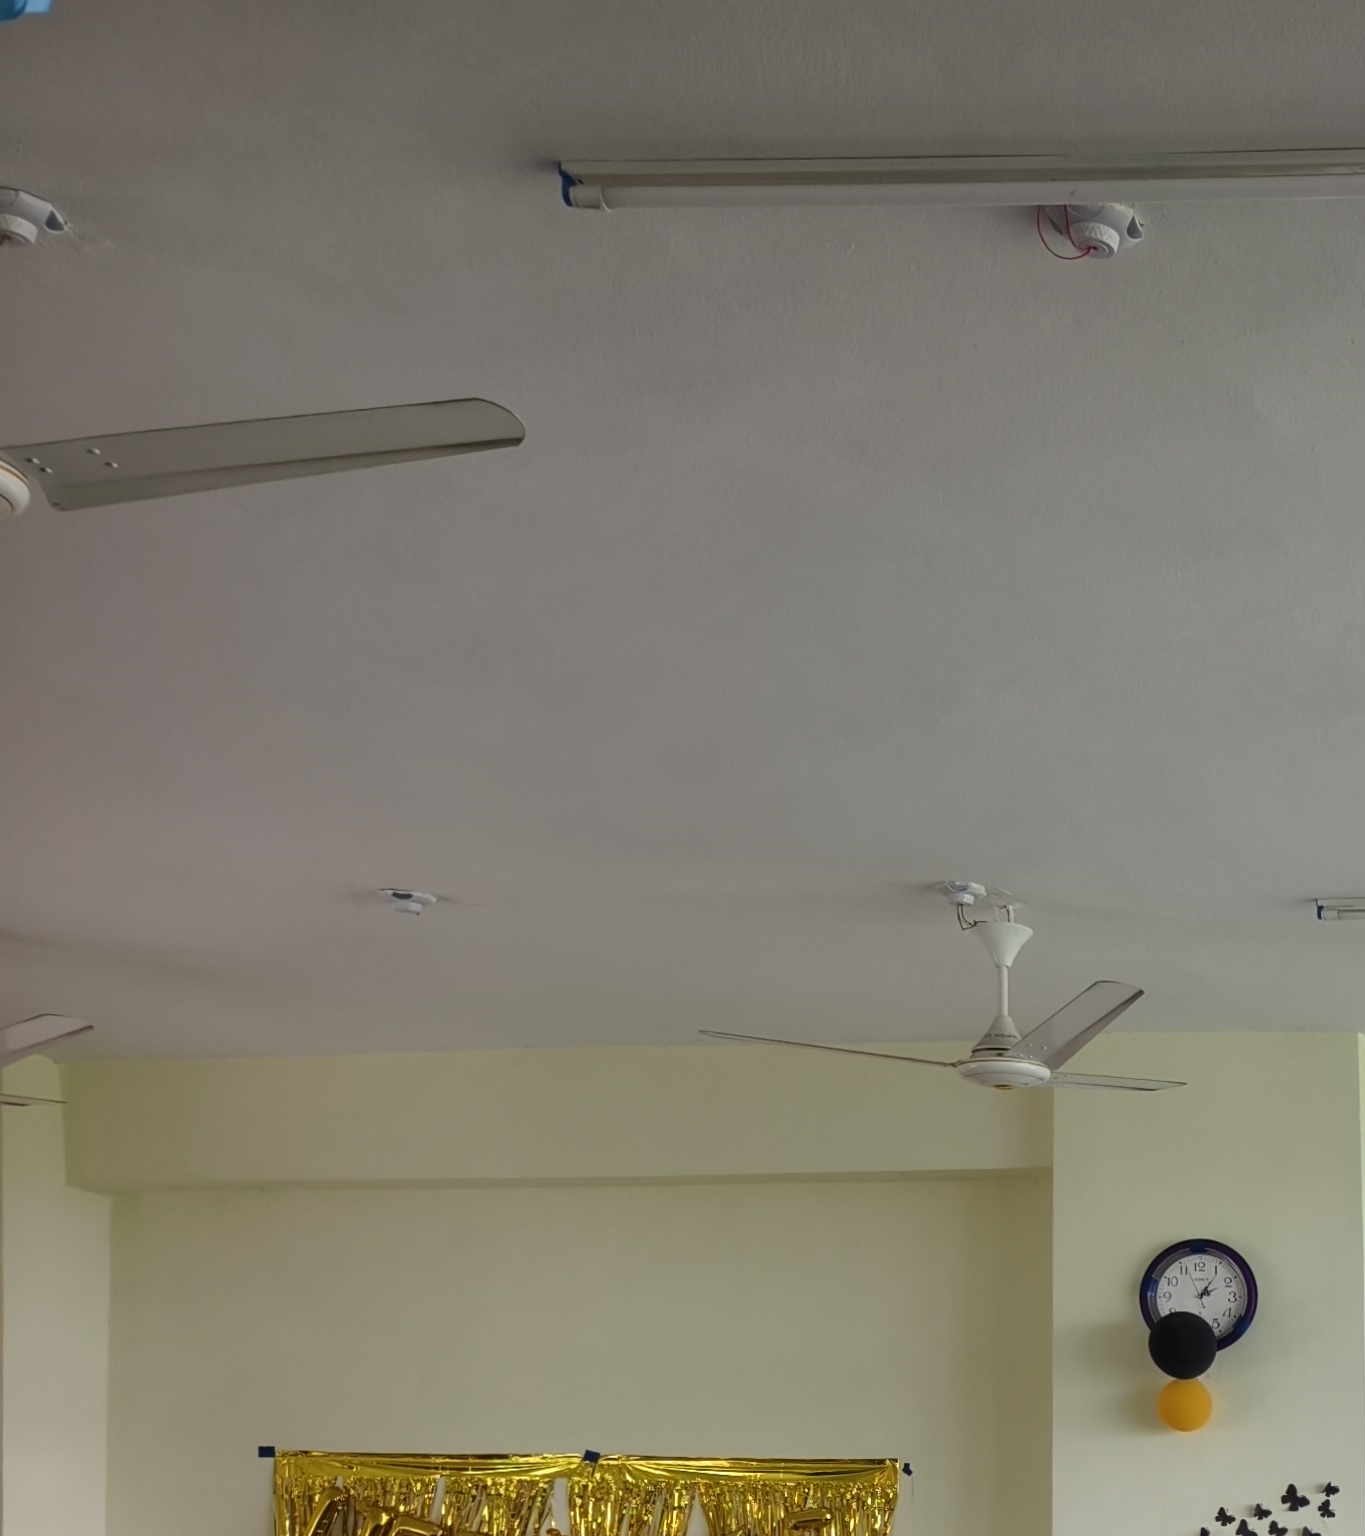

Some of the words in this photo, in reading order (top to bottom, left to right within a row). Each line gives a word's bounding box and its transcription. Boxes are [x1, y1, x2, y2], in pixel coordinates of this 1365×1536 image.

[1180, 1265, 1188, 1275] 11
[1195, 1262, 1206, 1272] 12
[1167, 1276, 1179, 1287] 10
[1163, 1291, 1172, 1303] 9
[1228, 1291, 1237, 1303] 3
[1223, 1307, 1232, 1318] 4
[1212, 1318, 1220, 1329] 5
